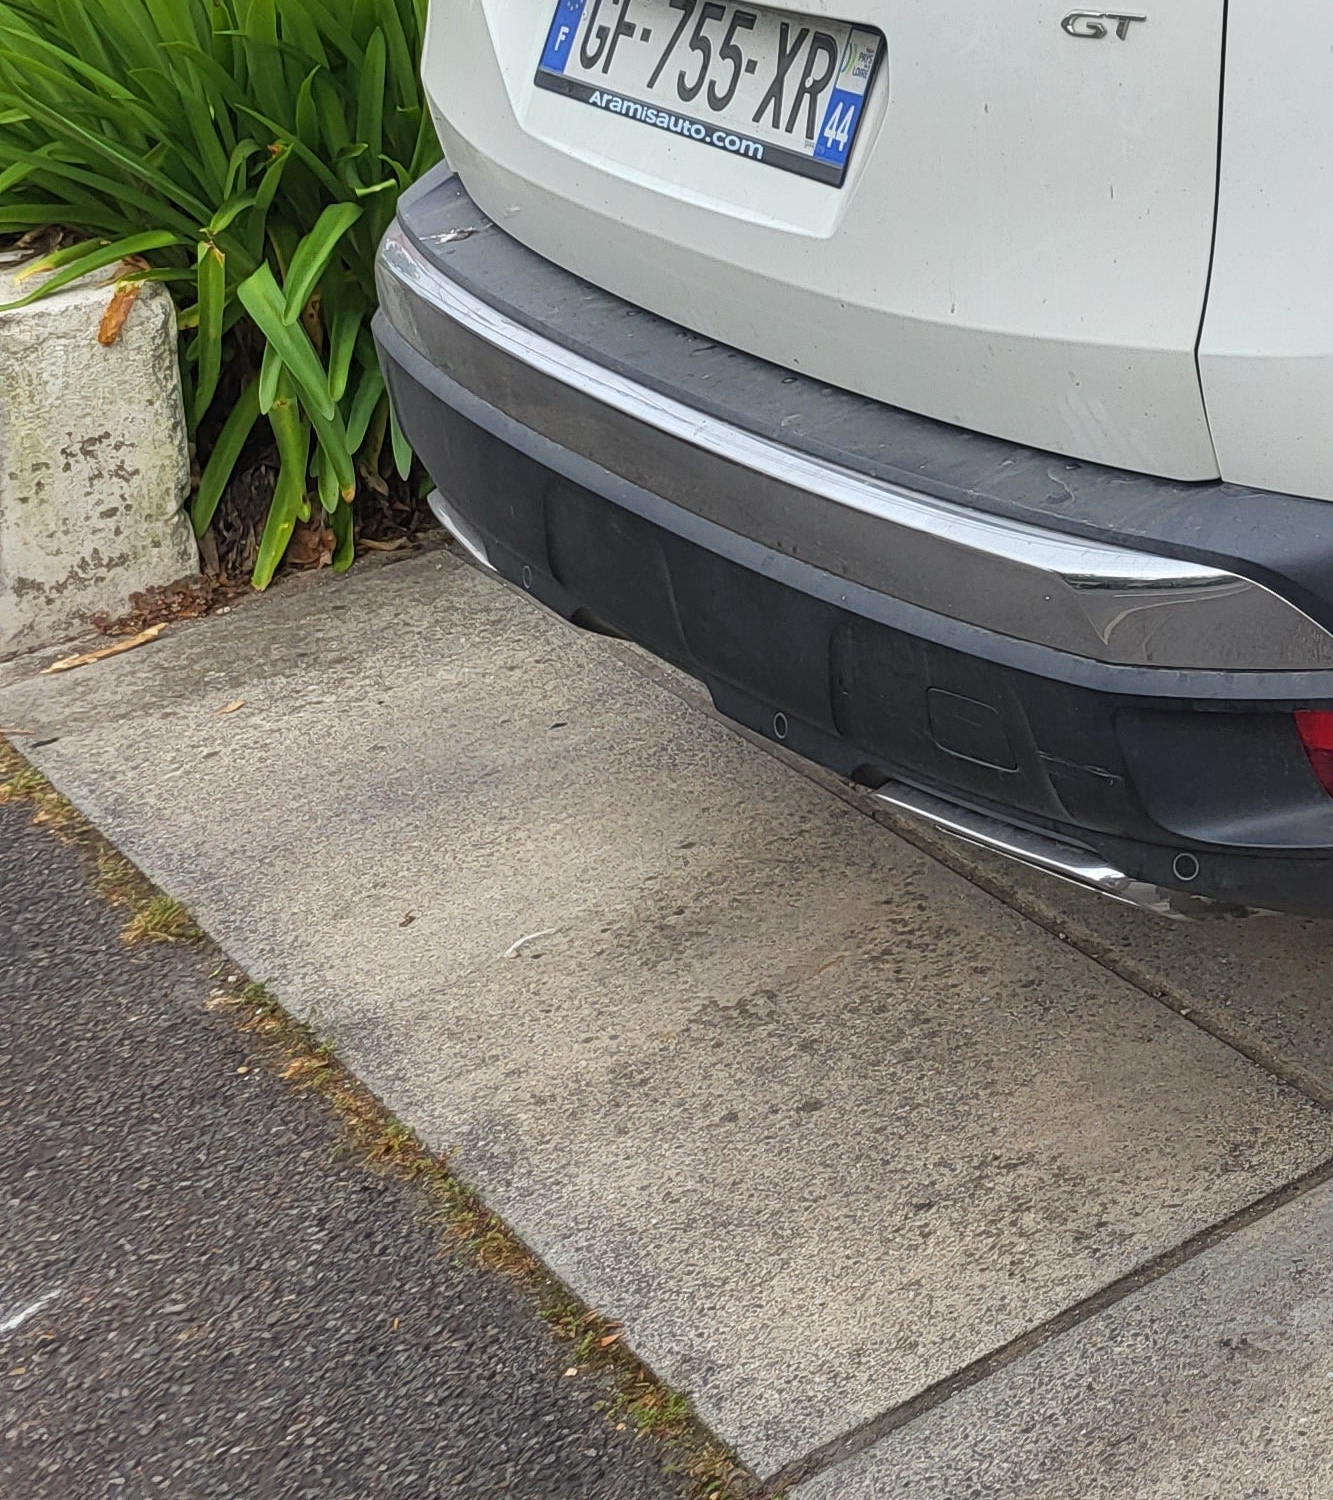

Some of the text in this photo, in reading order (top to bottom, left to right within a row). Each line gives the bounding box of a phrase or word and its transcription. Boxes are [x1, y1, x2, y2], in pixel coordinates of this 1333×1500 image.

[1060, 9, 1147, 42] GT
[554, 25, 570, 52] F
[824, 101, 858, 153] 44
[588, 89, 765, 161] Aramisauto.com
